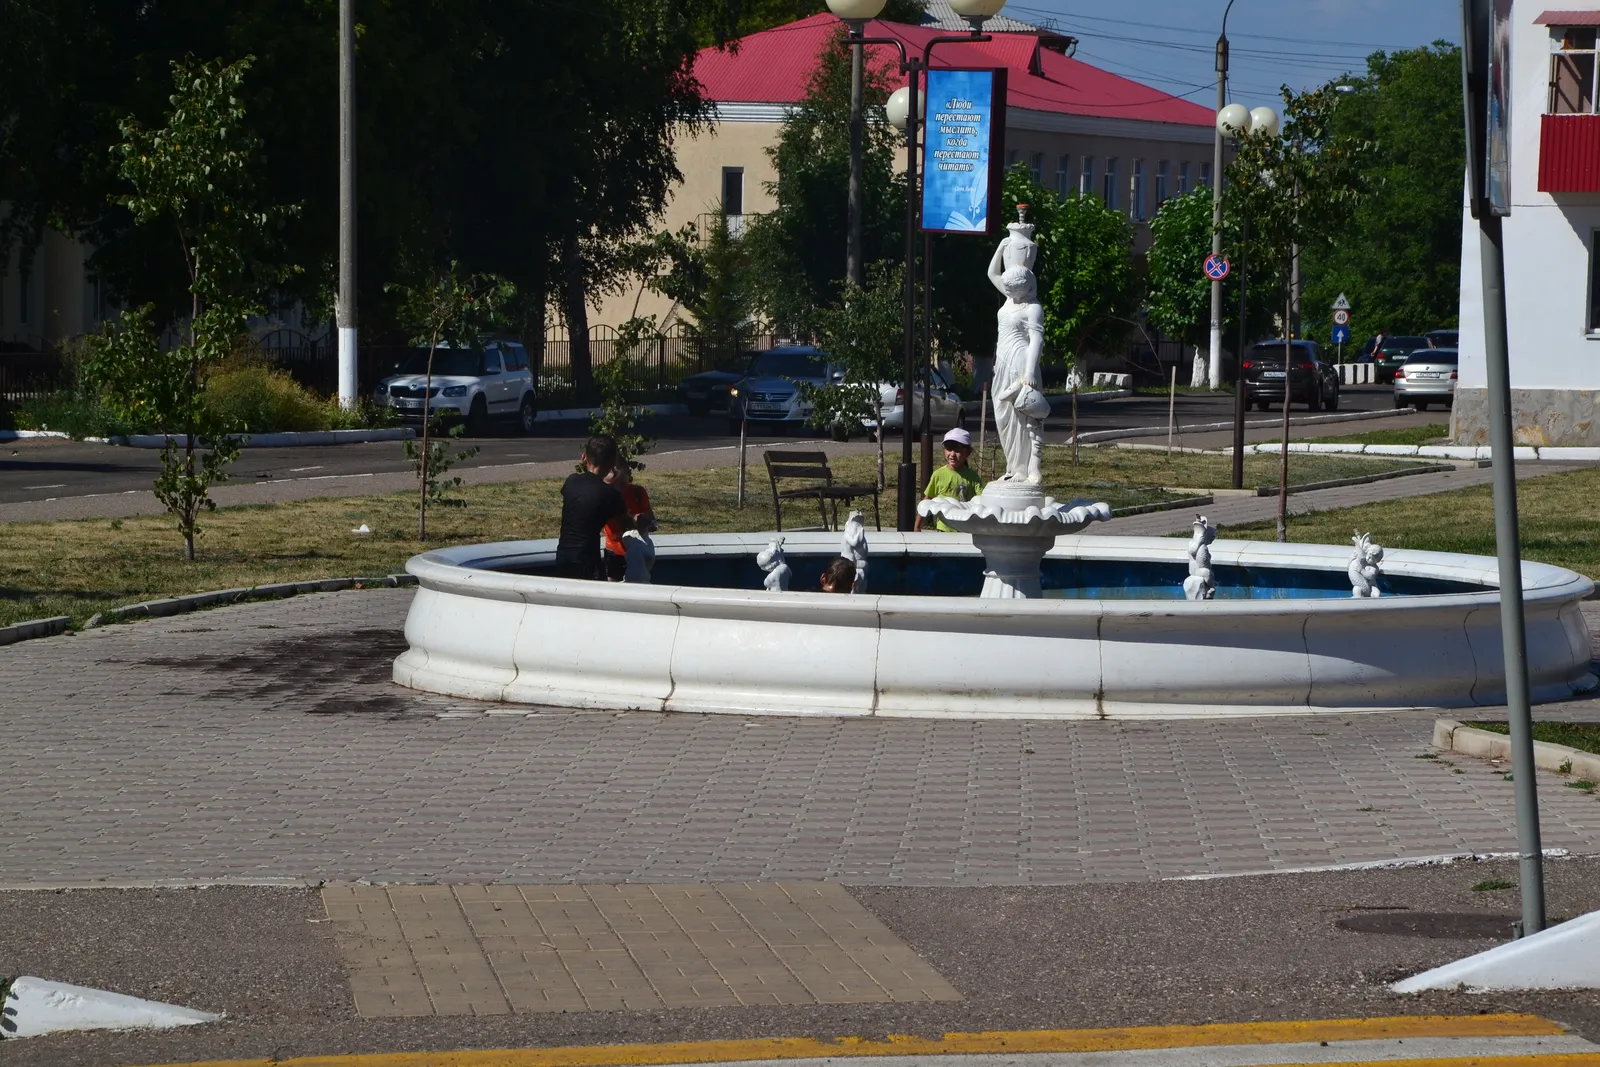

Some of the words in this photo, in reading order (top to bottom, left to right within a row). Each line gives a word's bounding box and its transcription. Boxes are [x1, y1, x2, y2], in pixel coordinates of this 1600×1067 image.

[945, 97, 972, 109] «Люди
[935, 113, 981, 124] перестают
[939, 126, 978, 136] мыслить,
[946, 137, 968, 146] когда
[934, 150, 980, 161] перестают
[938, 162, 974, 171] читать»
[1336, 312, 1346, 322] 40
